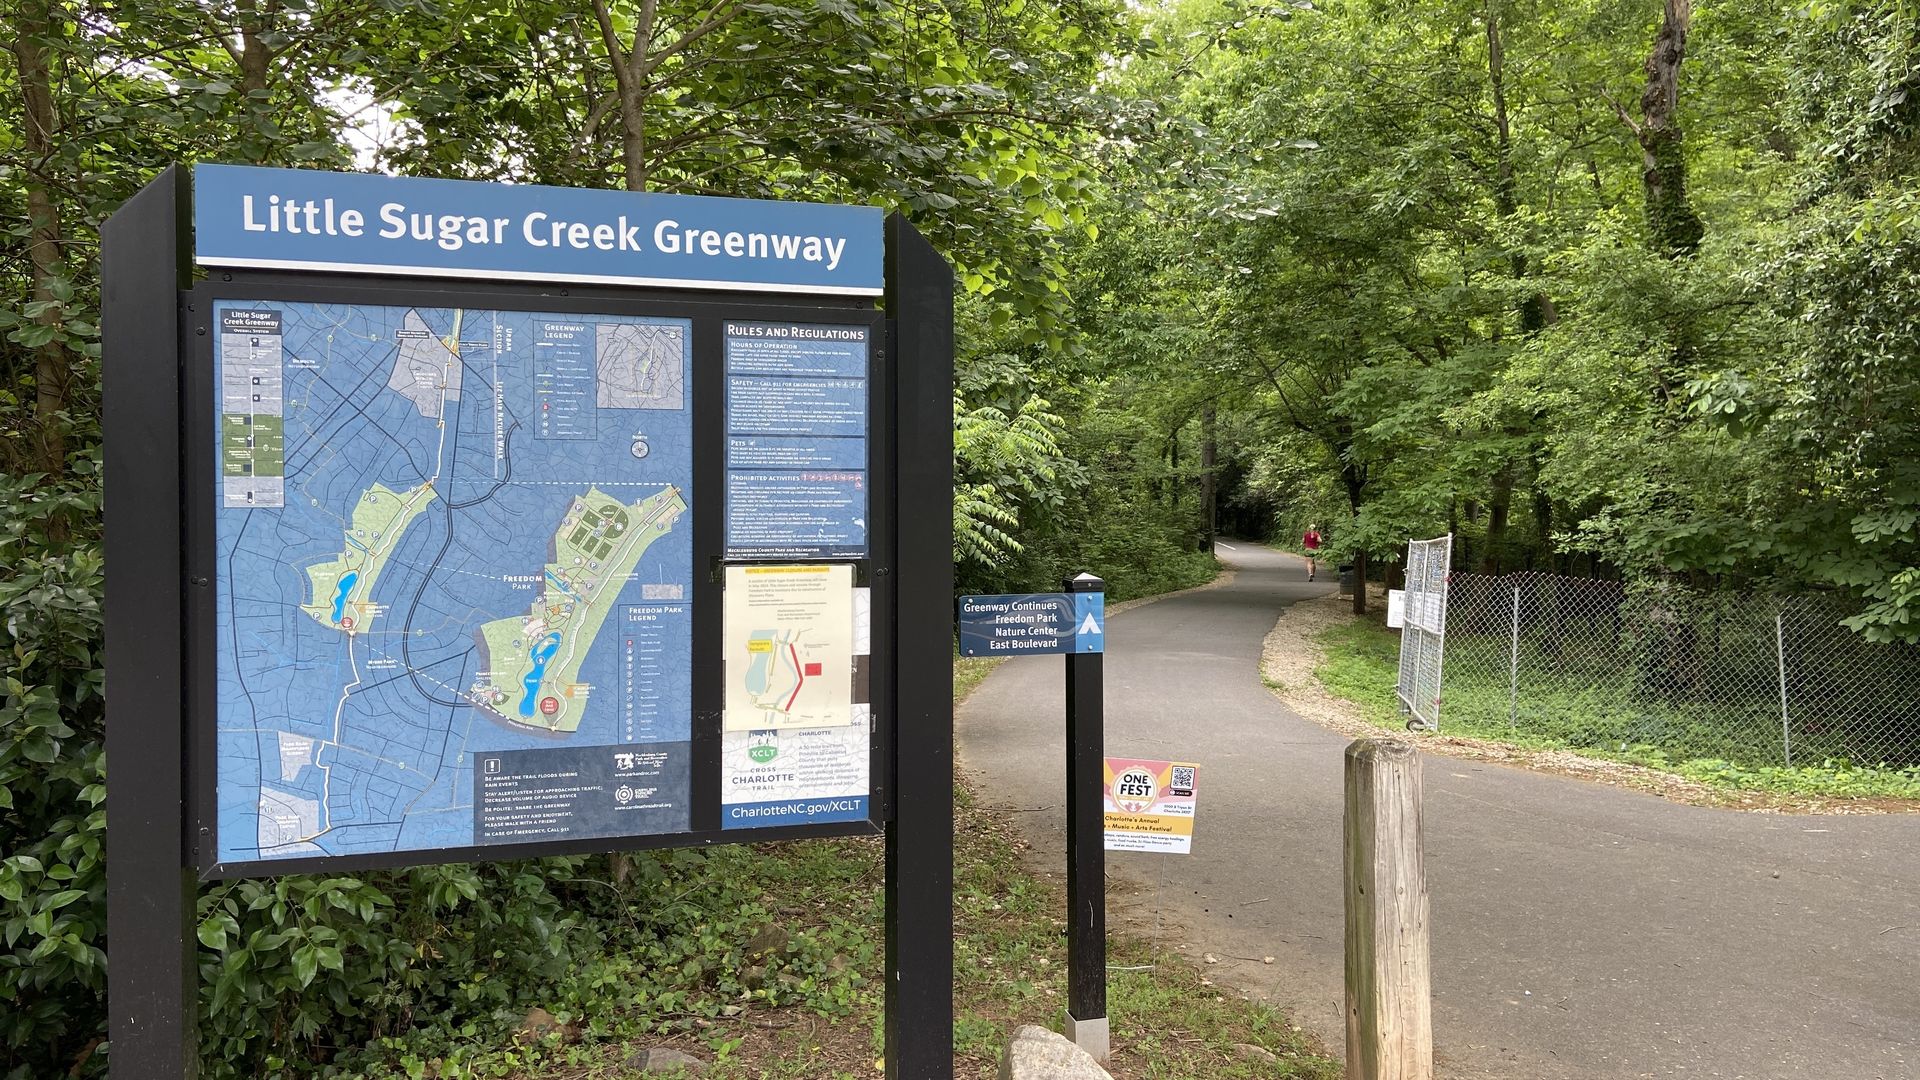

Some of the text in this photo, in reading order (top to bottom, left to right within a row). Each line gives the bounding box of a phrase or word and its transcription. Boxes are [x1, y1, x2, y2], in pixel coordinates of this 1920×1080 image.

[243, 194, 847, 271] Little Sugar Creek Greenway
[231, 311, 272, 320] Little Sugar
[223, 318, 279, 327] Creek Greenway
[544, 323, 585, 332] GREENWAY
[544, 331, 574, 339] LEGEND
[728, 324, 864, 340] RULES AND REGULATIONS
[503, 574, 542, 582] FREEDOM
[964, 601, 1057, 613] Greenway Continues
[995, 613, 1057, 624] Freedom Park
[995, 626, 1057, 637] Nature Center
[990, 638, 1057, 650] East Boulevard
[751, 749, 776, 758] XCLT
[732, 773, 794, 785] CHARLOTTE
[1123, 774, 1148, 785] ONE
[1120, 784, 1151, 796] FEST
[731, 799, 861, 818] CharlotteNC.gov/XCLT
[1105, 815, 1138, 823] Charlotte's
